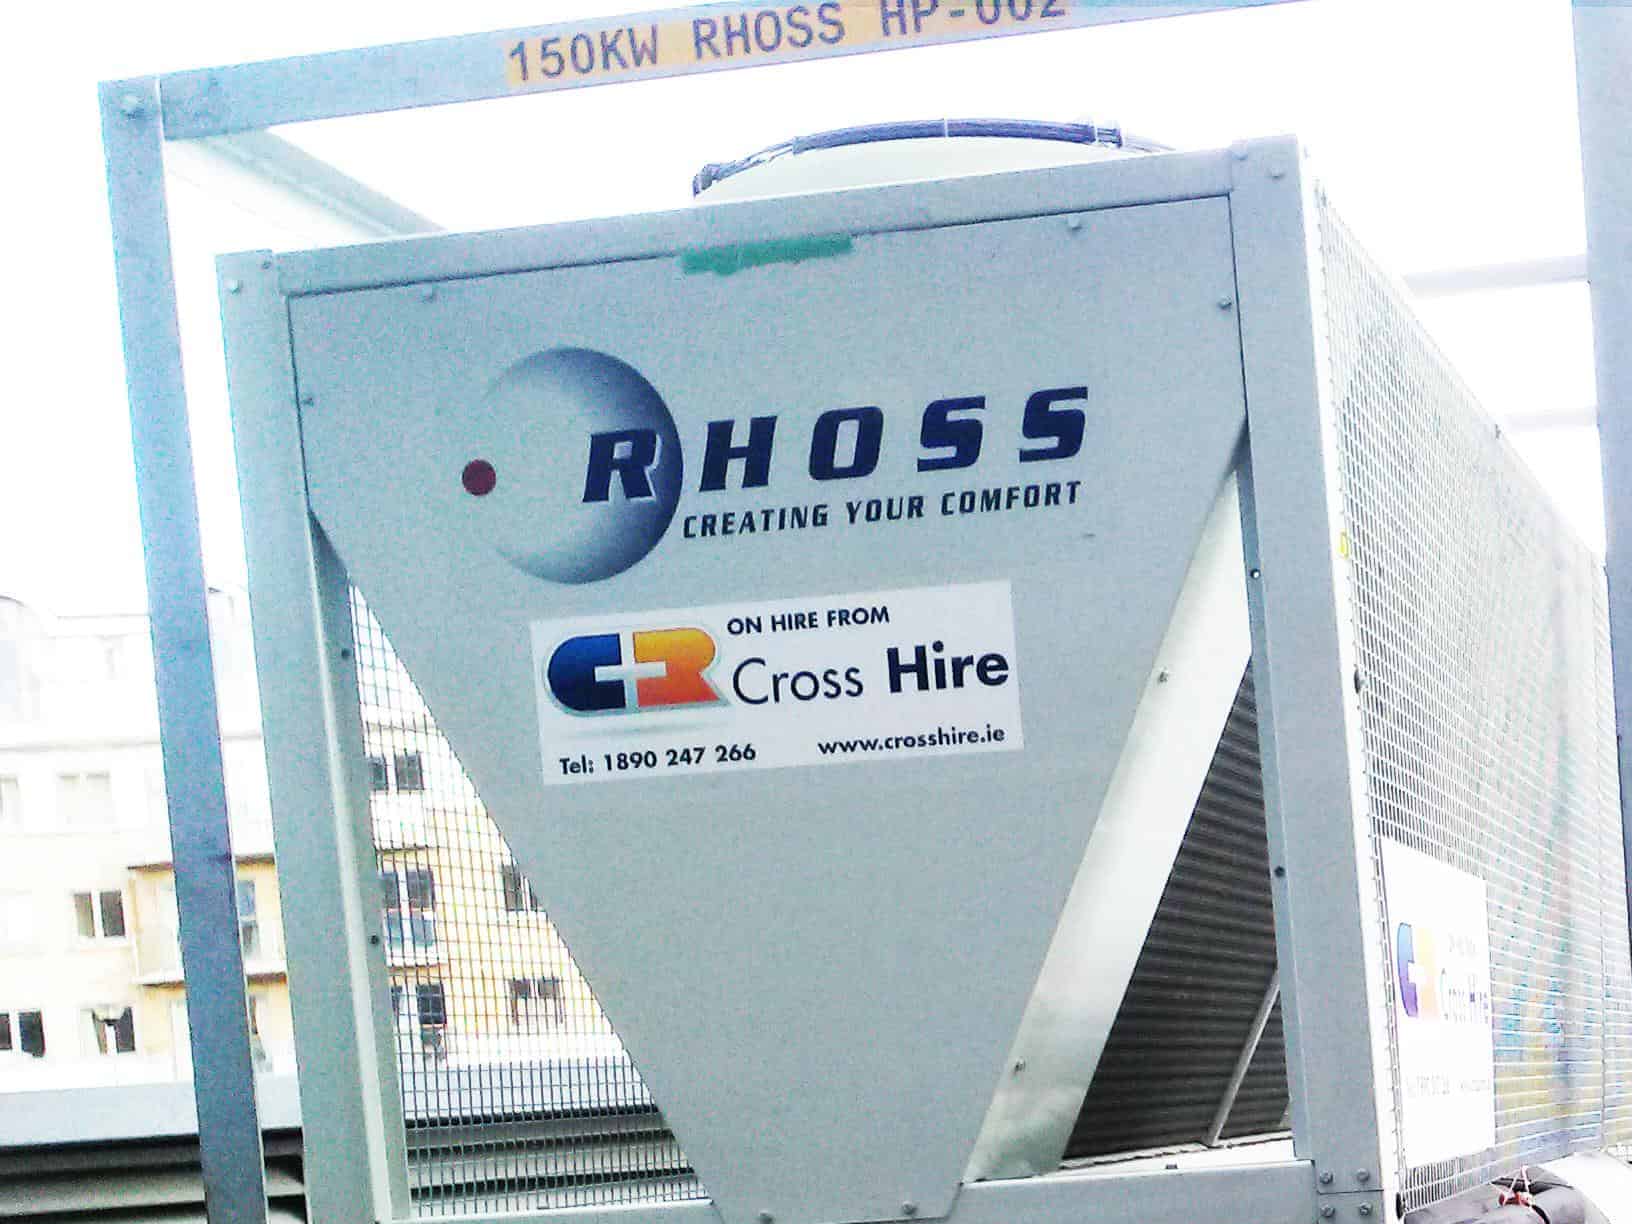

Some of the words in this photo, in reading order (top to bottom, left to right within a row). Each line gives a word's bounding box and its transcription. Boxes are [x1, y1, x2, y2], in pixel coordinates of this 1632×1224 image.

[509, 24, 658, 81] 150KW
[691, 2, 846, 60] RHOSS
[582, 386, 1090, 504] RHOSS
[683, 504, 829, 539] CREATING
[846, 495, 925, 525] YOUR
[941, 480, 1082, 516] COMFORT
[726, 617, 763, 636] ON
[770, 611, 819, 633] HIRE
[827, 605, 890, 627] FROM
[732, 656, 864, 706] Cross
[886, 640, 1010, 694] Hire
[559, 756, 595, 776] Tel:
[603, 751, 658, 772] 1890
[666, 747, 706, 767] 247
[714, 743, 757, 763] 266
[817, 723, 1006, 756] www.crosshire.ie
